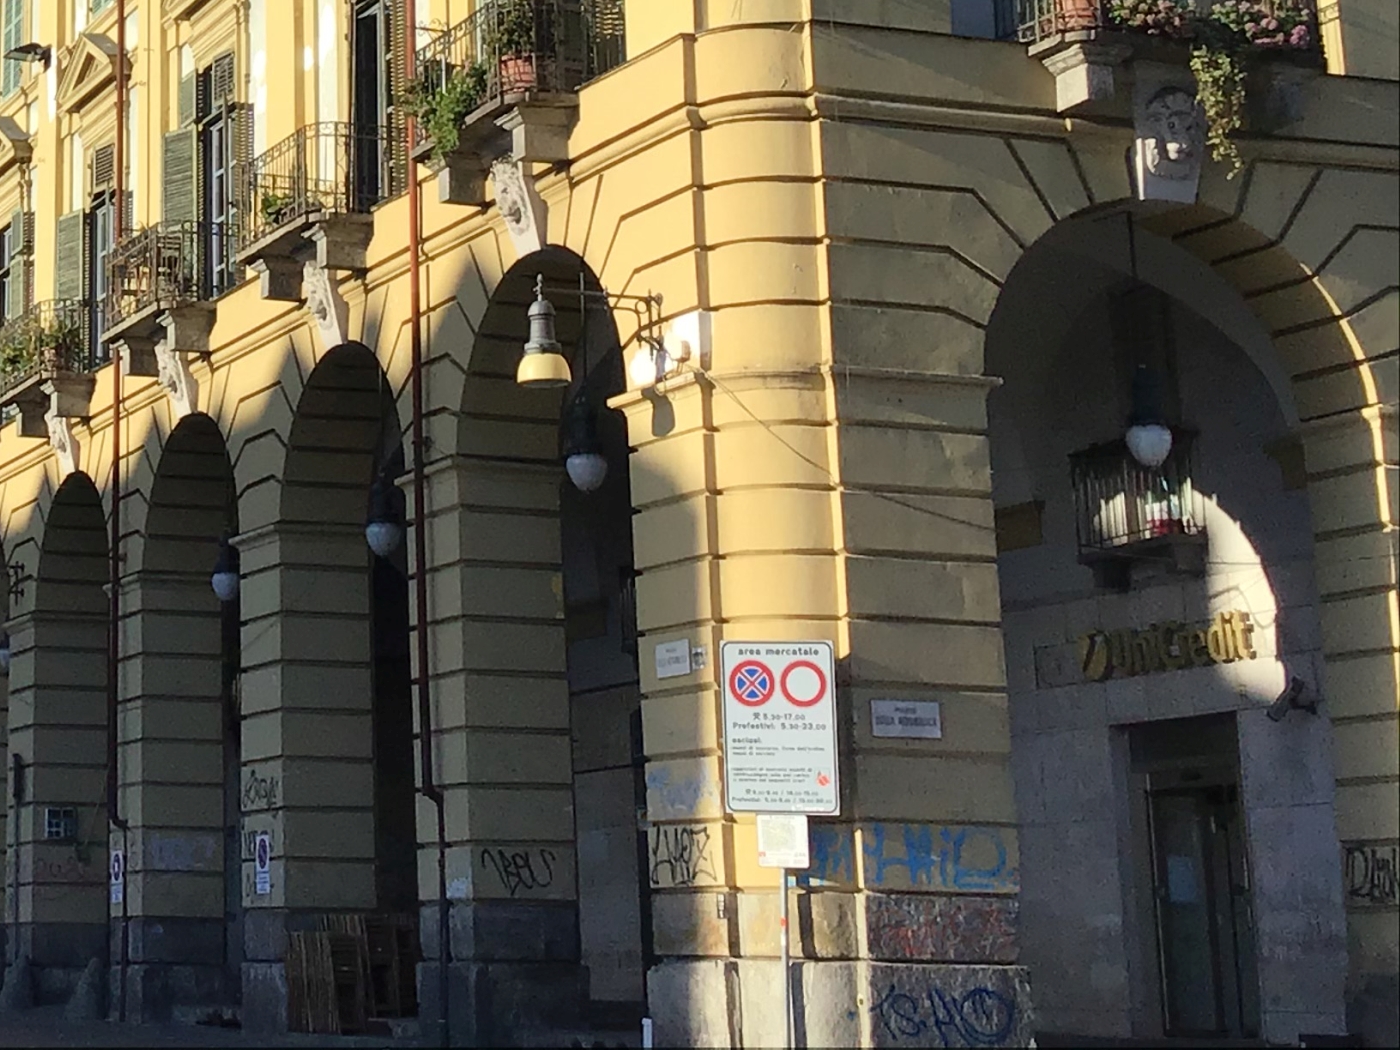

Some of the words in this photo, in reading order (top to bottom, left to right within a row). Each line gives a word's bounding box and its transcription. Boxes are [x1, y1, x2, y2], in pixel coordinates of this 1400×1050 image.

[738, 648, 762, 656] area
[765, 647, 820, 656] mercatale
[1111, 608, 1257, 677] UniCredit
